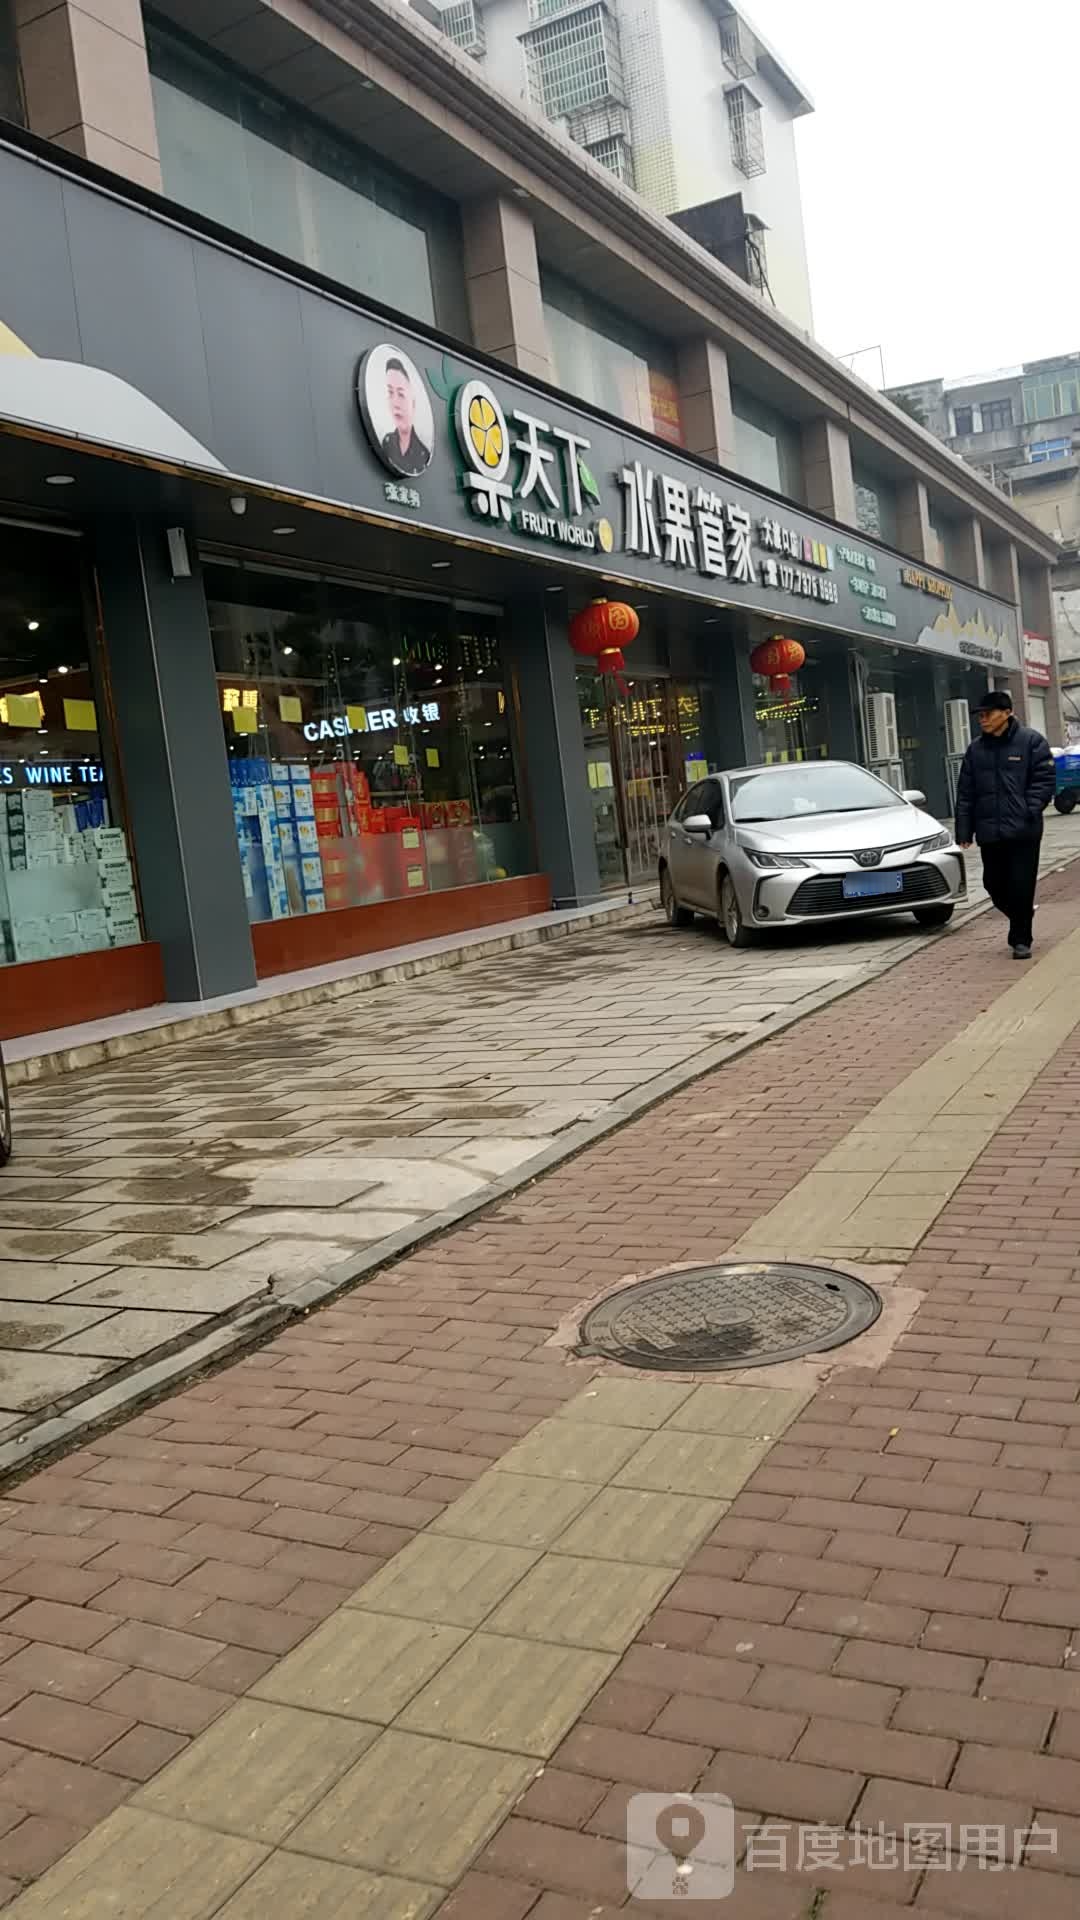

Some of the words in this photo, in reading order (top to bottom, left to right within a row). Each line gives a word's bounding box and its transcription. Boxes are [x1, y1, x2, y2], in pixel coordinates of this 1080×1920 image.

[521, 510, 556, 538] FRUIT
[557, 521, 594, 548] WORLD
[620, 460, 757, 583] 水果管家
[303, 708, 398, 741] CASER
[403, 702, 440, 725] 收银
[24, 766, 73, 784] WINE
